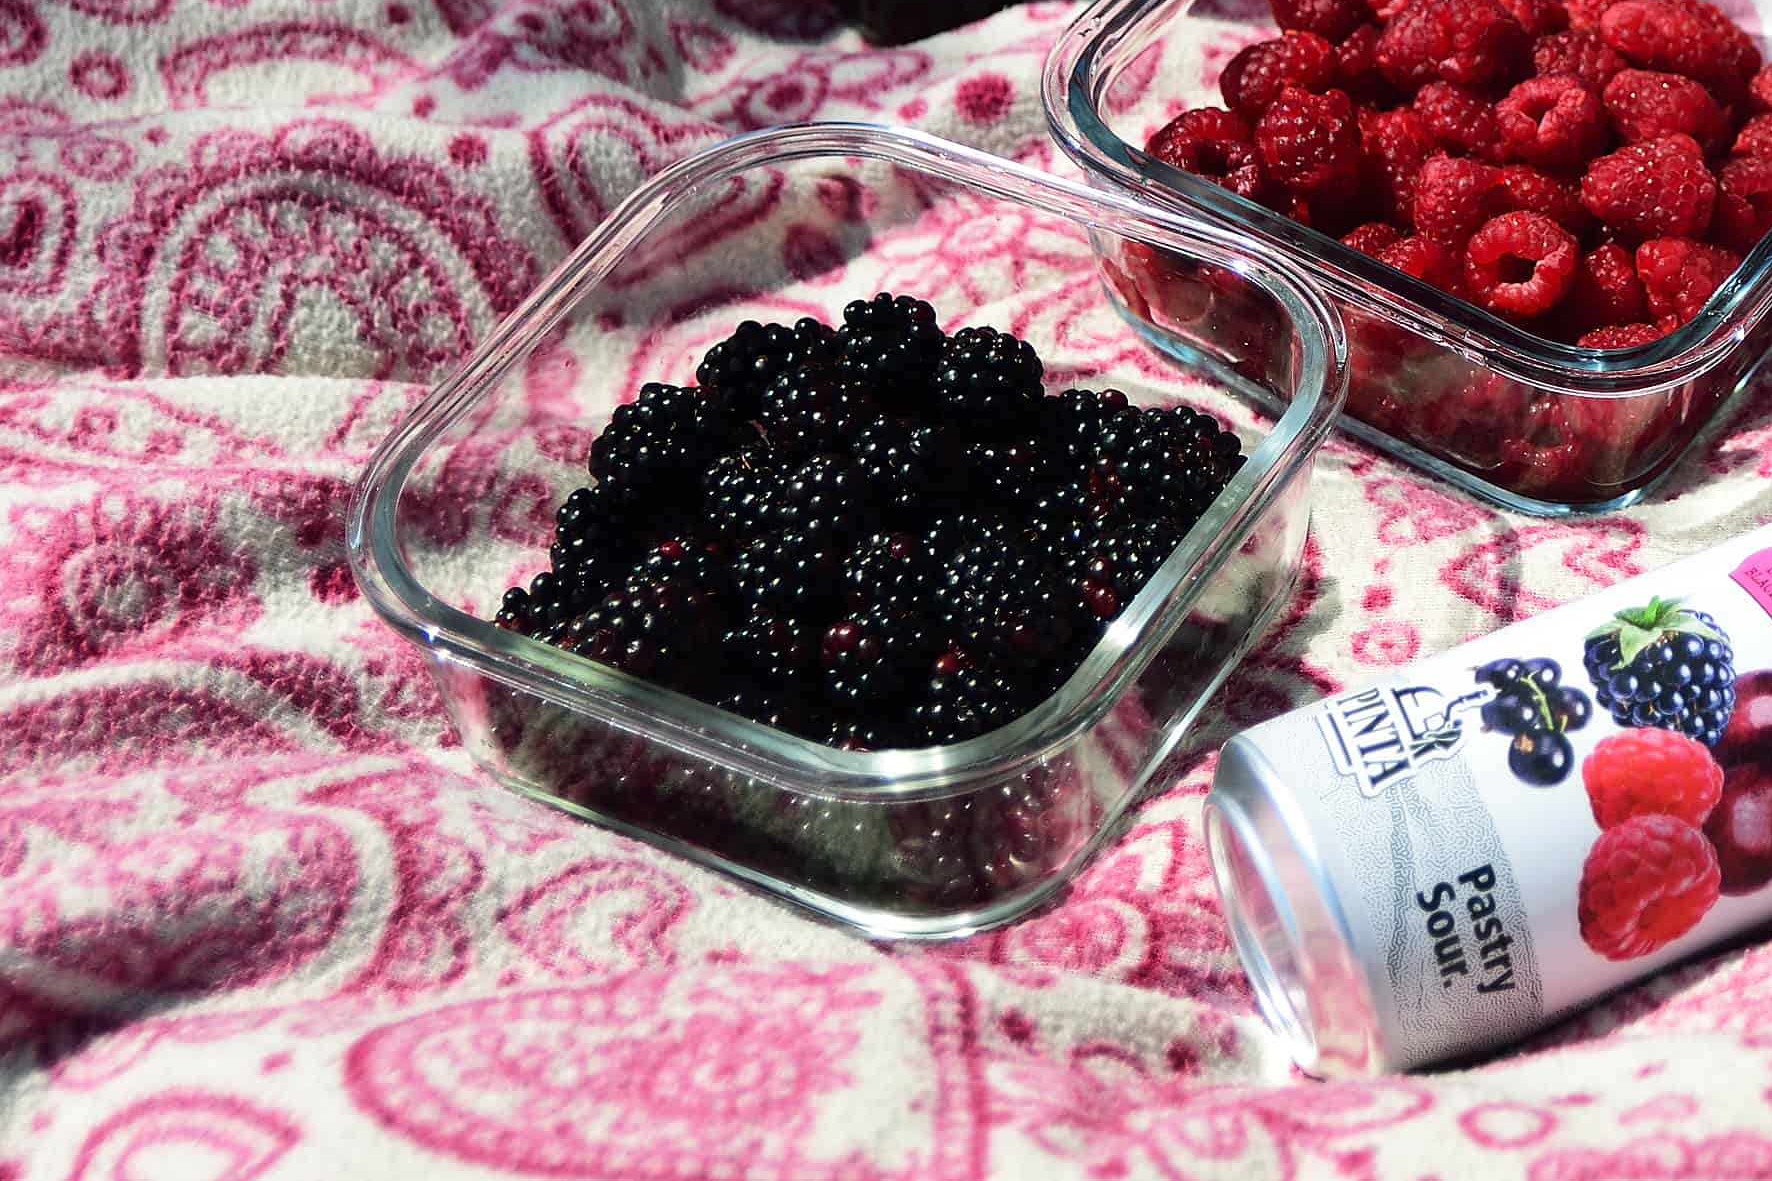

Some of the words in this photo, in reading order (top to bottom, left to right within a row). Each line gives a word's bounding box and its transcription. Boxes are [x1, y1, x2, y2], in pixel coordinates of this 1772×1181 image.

[1336, 687, 1409, 790] PINTA
[1416, 882, 1469, 989] Sour.
[1457, 864, 1516, 994] Pastry
